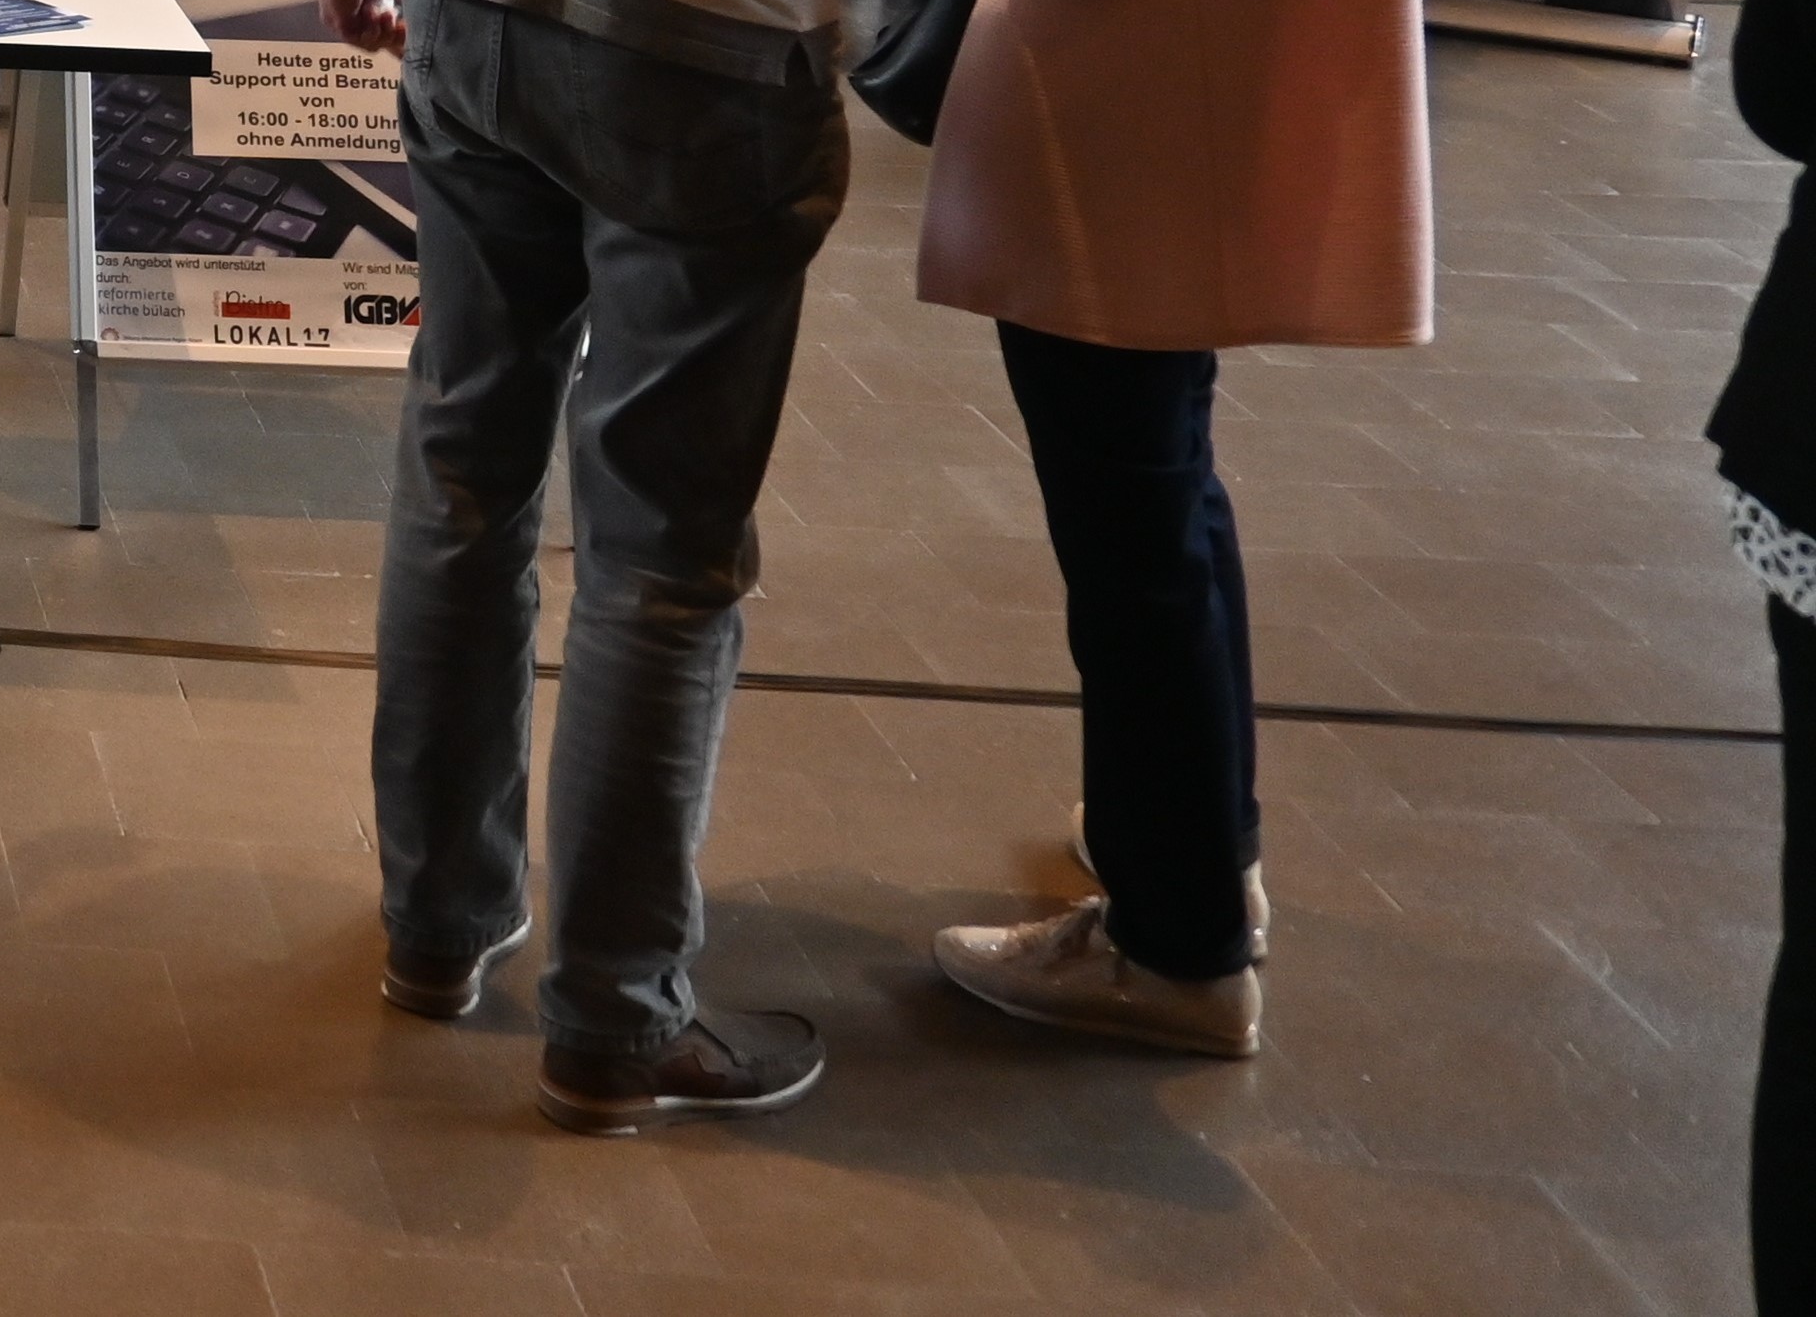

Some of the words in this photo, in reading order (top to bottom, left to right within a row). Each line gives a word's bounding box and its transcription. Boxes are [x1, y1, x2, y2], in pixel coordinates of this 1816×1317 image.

[257, 51, 313, 69] Heute
[318, 53, 374, 71] gratis
[208, 69, 287, 90] Support
[291, 72, 329, 89] und
[334, 73, 400, 91] Beratu
[298, 95, 336, 109] von
[236, 110, 289, 128] 16:00
[307, 112, 359, 129] 18:00
[364, 114, 400, 131] Uhr
[235, 131, 286, 148] ohne
[289, 132, 402, 154] Anmeldung
[95, 254, 120, 268] Das
[121, 255, 173, 272] Angebot
[174, 257, 201, 271] wird
[203, 258, 267, 273] unterstützt
[342, 261, 365, 275] Wir
[366, 262, 392, 276] sind
[394, 263, 420, 278] Mit
[95, 271, 133, 285] durch:
[343, 281, 368, 292] von:
[97, 286, 176, 303] reformierte
[98, 303, 140, 318] kirche
[142, 304, 186, 319] bülach
[213, 324, 299, 346] LOKAL
[303, 326, 331, 342] 17
